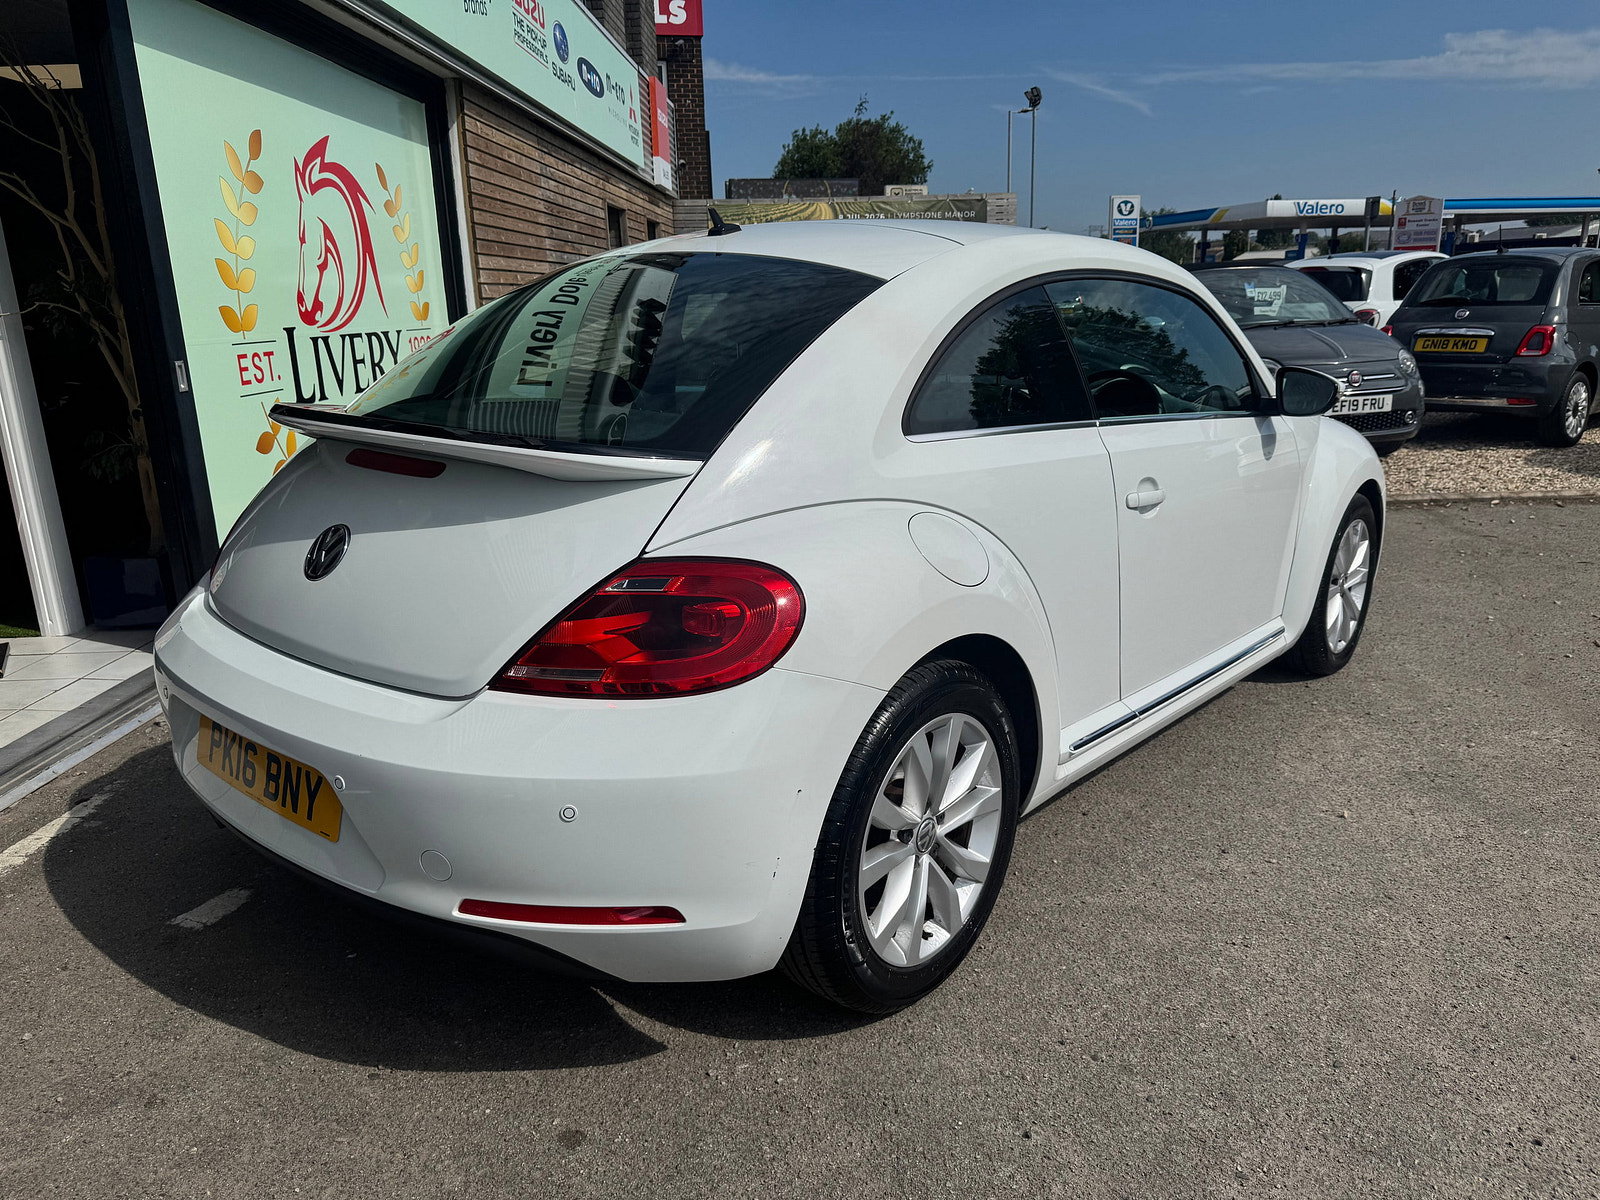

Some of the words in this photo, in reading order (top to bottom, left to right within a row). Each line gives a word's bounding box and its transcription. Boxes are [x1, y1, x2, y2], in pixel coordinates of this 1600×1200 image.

[512, 11, 525, 33] THE
[526, 23, 547, 51] PICK-UP
[552, 61, 576, 92] SUBARU
[893, 211, 942, 219] LYMPSTONE
[944, 210, 976, 218] MANOR
[1296, 201, 1345, 215] Valero
[1421, 339, 1450, 349] GN18
[237, 351, 282, 386] EST.
[1331, 400, 1359, 413] EF19
[1360, 397, 1385, 411] FRU
[208, 721, 258, 789] PK16
[263, 751, 324, 822] BNY
